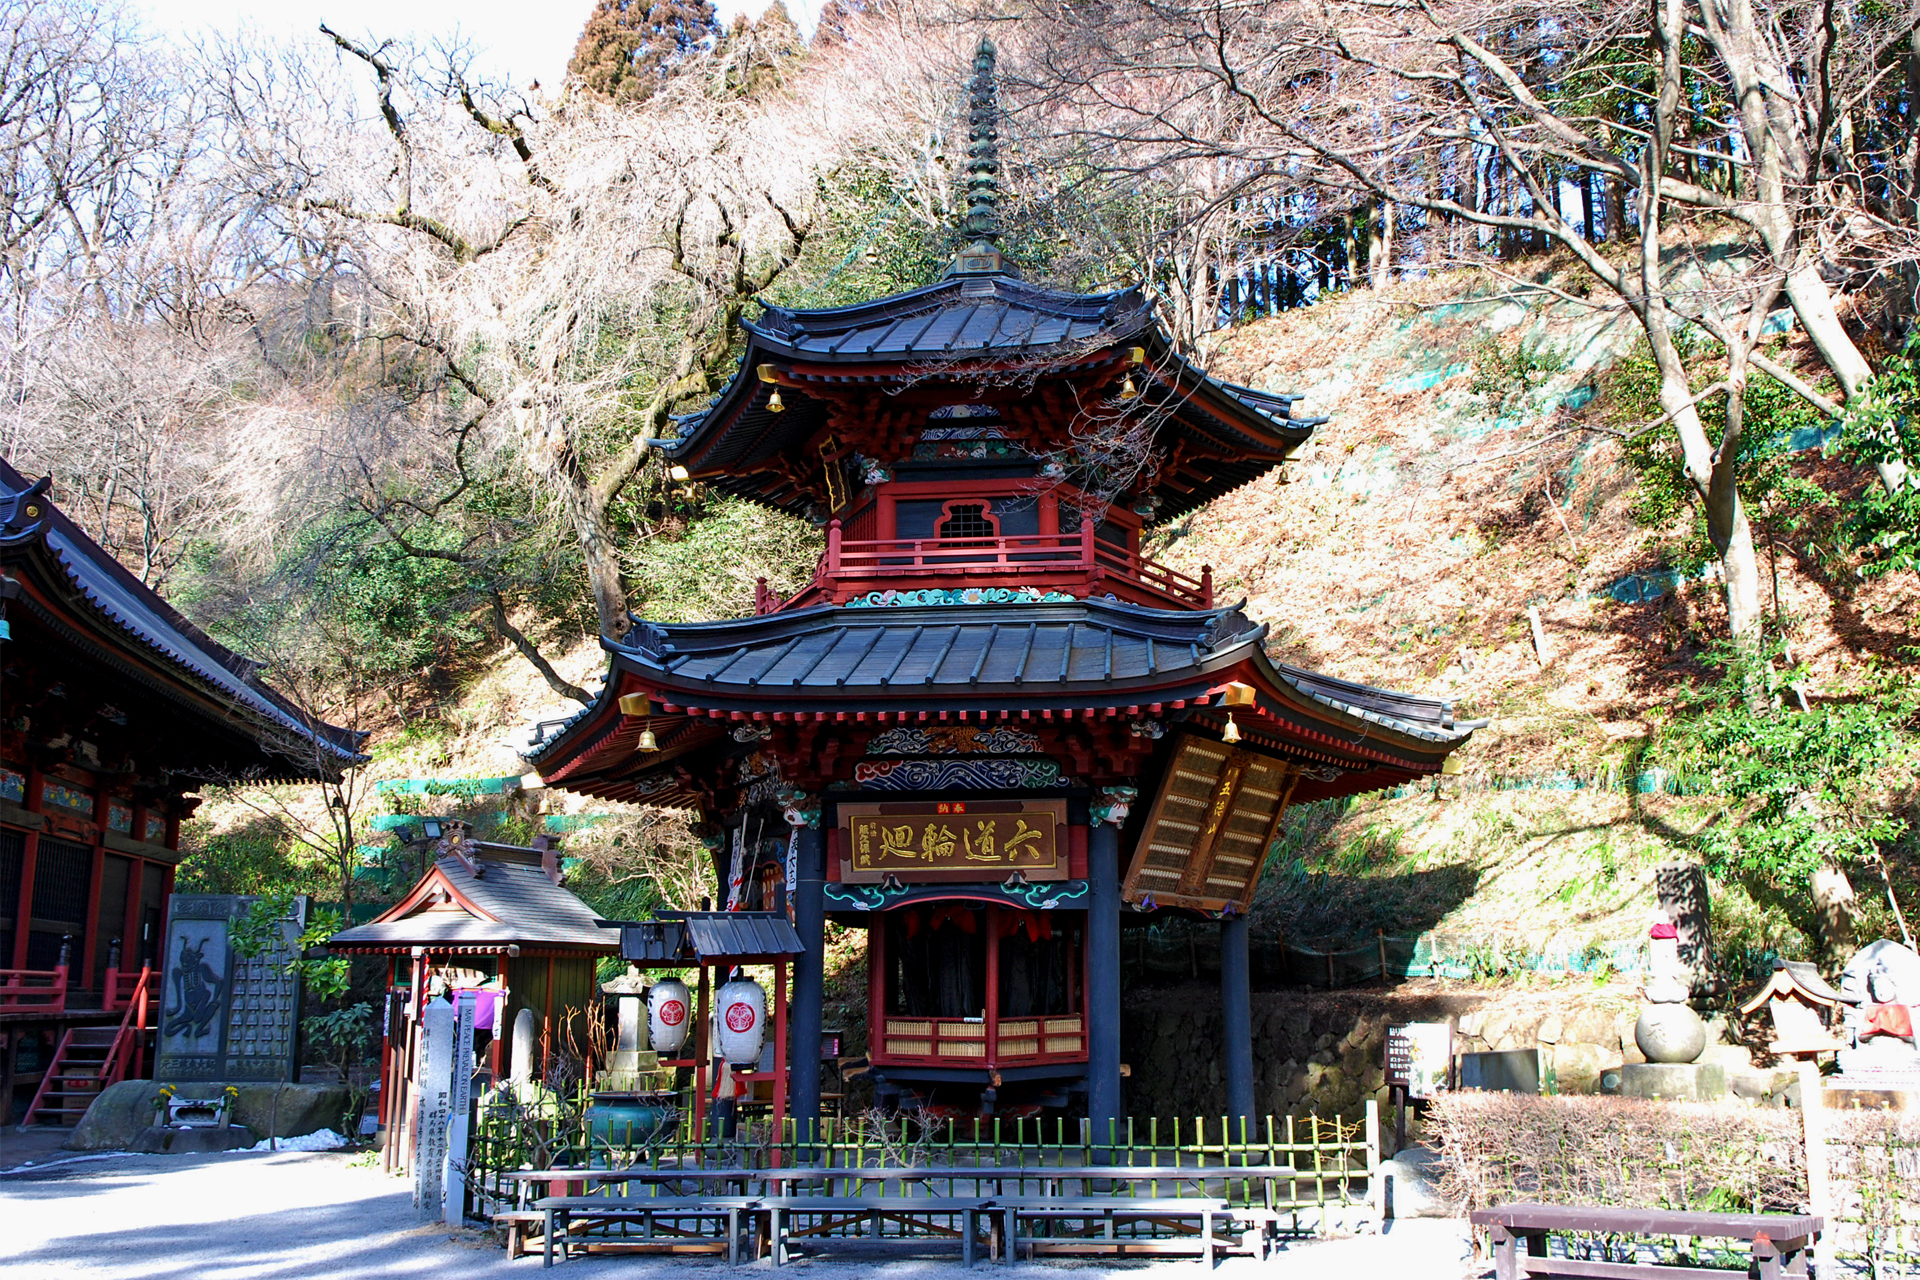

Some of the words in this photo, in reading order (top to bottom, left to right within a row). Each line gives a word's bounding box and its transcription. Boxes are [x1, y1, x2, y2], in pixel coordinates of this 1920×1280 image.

[464, 1008, 472, 1024] MAY
[463, 1025, 472, 1046] PEACE
[461, 1048, 471, 1074] PREVAIL
[459, 1085, 468, 1111] EARTH
